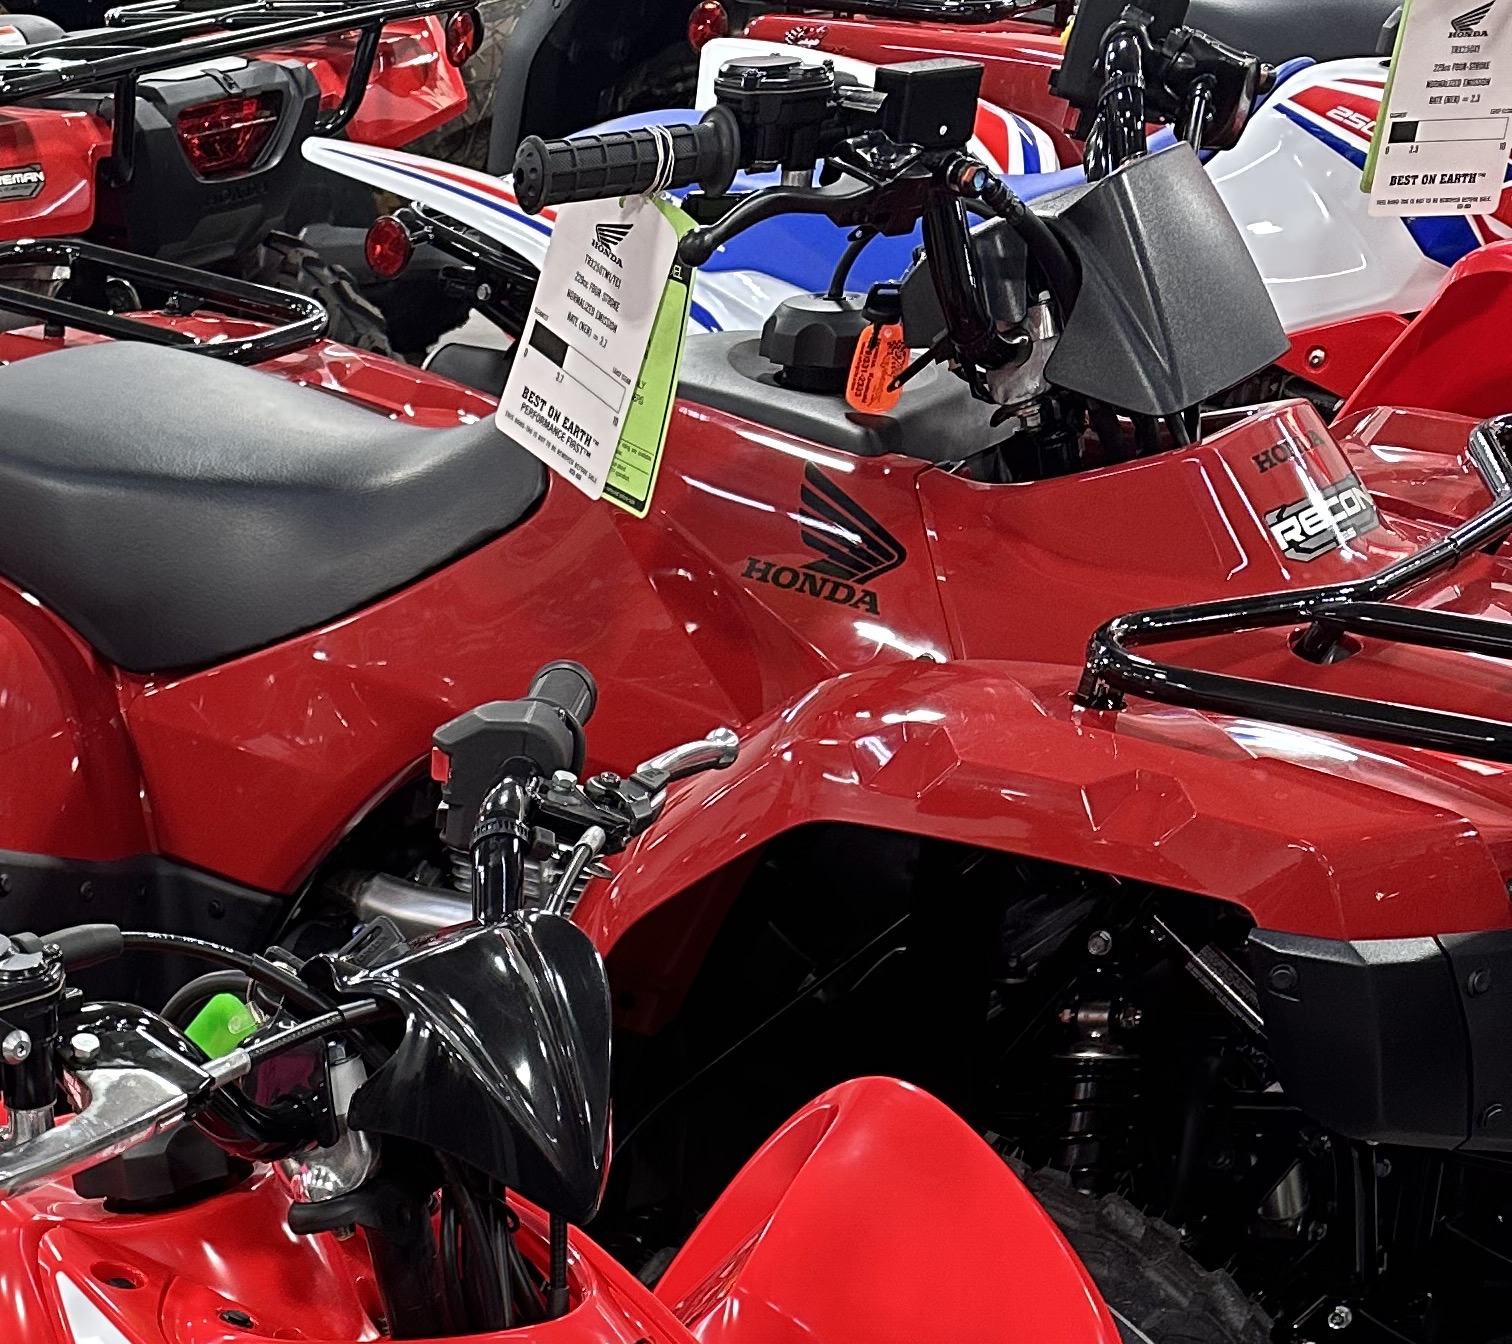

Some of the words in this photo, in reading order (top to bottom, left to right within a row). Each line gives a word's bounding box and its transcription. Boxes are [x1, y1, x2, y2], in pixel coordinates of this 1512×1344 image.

[1389, 174, 1420, 186] BEST
[1421, 173, 1437, 185] ON
[591, 238, 623, 269] HONDA
[520, 403, 566, 443] PERFORMANCE
[521, 386, 547, 414] BEST
[547, 405, 561, 423] ON
[1251, 429, 1325, 473] HOA
[741, 556, 881, 616] HONDA
